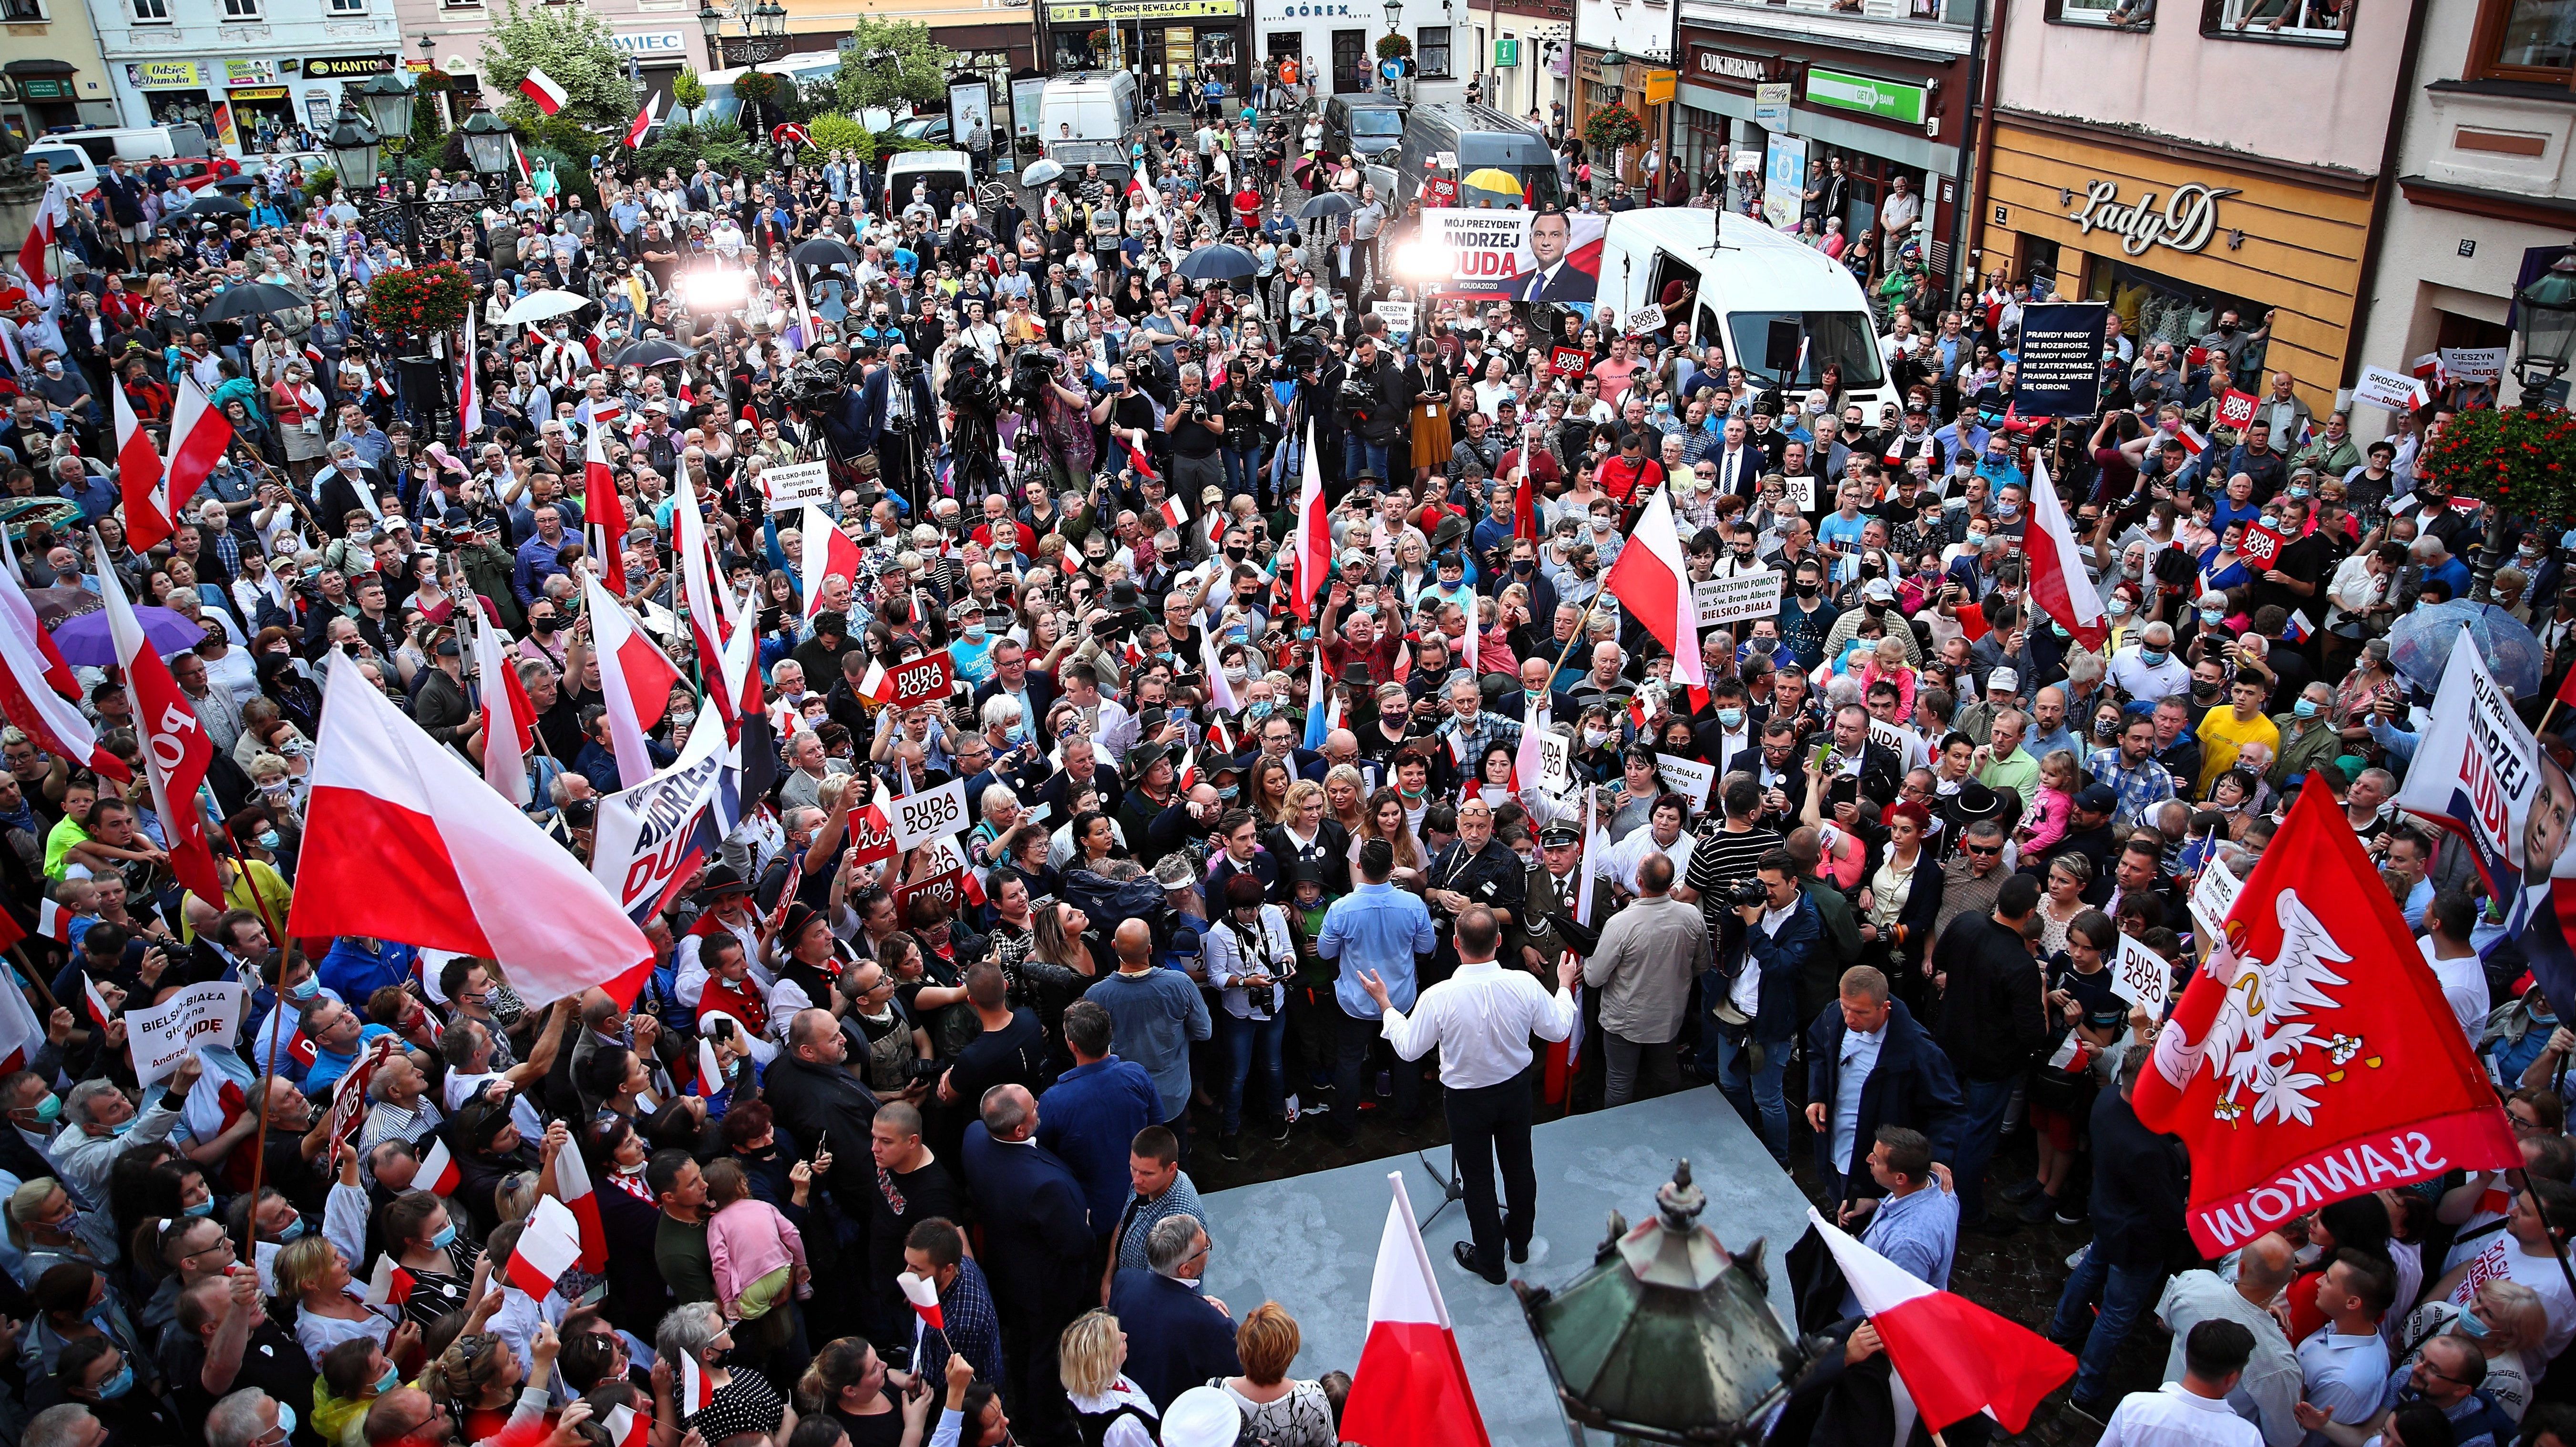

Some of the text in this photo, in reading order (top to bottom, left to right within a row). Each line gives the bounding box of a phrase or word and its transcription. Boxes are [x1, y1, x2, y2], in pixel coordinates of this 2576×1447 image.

[1143, 2, 1191, 12] REWELACJE
[1285, 1, 1348, 16] GÓREX
[152, 65, 186, 75] Odzież
[228, 62, 251, 71] Odzież
[233, 68, 265, 77] Dziecięca
[332, 61, 380, 72] KANTO
[1701, 52, 1766, 81] CUKIERNIA
[143, 74, 189, 86] Damska
[1857, 89, 1895, 106] GET IN BANK
[1434, 185, 1453, 195] 2020
[1436, 181, 1453, 190] DUDA
[1444, 218, 1521, 229] MÓJ PREZYDENT
[2068, 180, 2242, 255] Lady D
[1443, 232, 1519, 248] ANDRZEJ
[2461, 241, 2473, 250] 22
[1631, 308, 1657, 322] DUDA
[1634, 315, 1660, 328] 2020
[1558, 352, 1584, 364] DUDA
[2452, 353, 2494, 361] CIESZYN
[1555, 361, 1583, 371] 2020
[2472, 368, 2499, 377] DUDĘ
[2021, 383, 2033, 391] SIĘ
[2369, 373, 2414, 392] SKOCZÓW
[2373, 385, 2394, 396] głosuje
[2226, 395, 2252, 412] DUDA
[2360, 392, 2408, 410] Andrzeja DUDĘ
[2221, 406, 2250, 421] 2020
[771, 469, 821, 481] BIELSKO-BIAŁA
[782, 480, 805, 488] głosuje
[1786, 483, 1808, 493] UDA
[775, 487, 823, 502] Andrzeja DUDĘ
[2247, 528, 2275, 551] DUDA
[2243, 538, 2271, 559] 2020
[1698, 575, 1779, 596] TOWARZYSTWO POMOCY
[1699, 589, 1775, 608] im. Św. Brata Alberta
[1702, 601, 1772, 620] BIELSKO-BIAŁA
[1784, 630, 1822, 642] PACIFIC
[898, 662, 942, 686] DUDA
[899, 675, 943, 699] 2020
[2468, 695, 2529, 802] ANDRZEJ
[1657, 764, 1703, 781] SKO-BIAŁA
[1661, 775, 1688, 788] suje na
[2458, 732, 2510, 860] DUDA
[633, 755, 717, 856] ANDRZEJ
[902, 791, 956, 822] DUDA
[905, 807, 958, 835] 2020
[2207, 862, 2232, 903] ŻYWIEC
[2209, 907, 2223, 930] DUD
[2125, 947, 2162, 988] DUDA
[2122, 965, 2160, 1003] 2020
[141, 991, 226, 1033] BIELSKO-BIAŁA
[192, 1005, 205, 1015] na
[185, 1018, 224, 1045] DUDĘ
[152, 1044, 189, 1069] Andrzej
